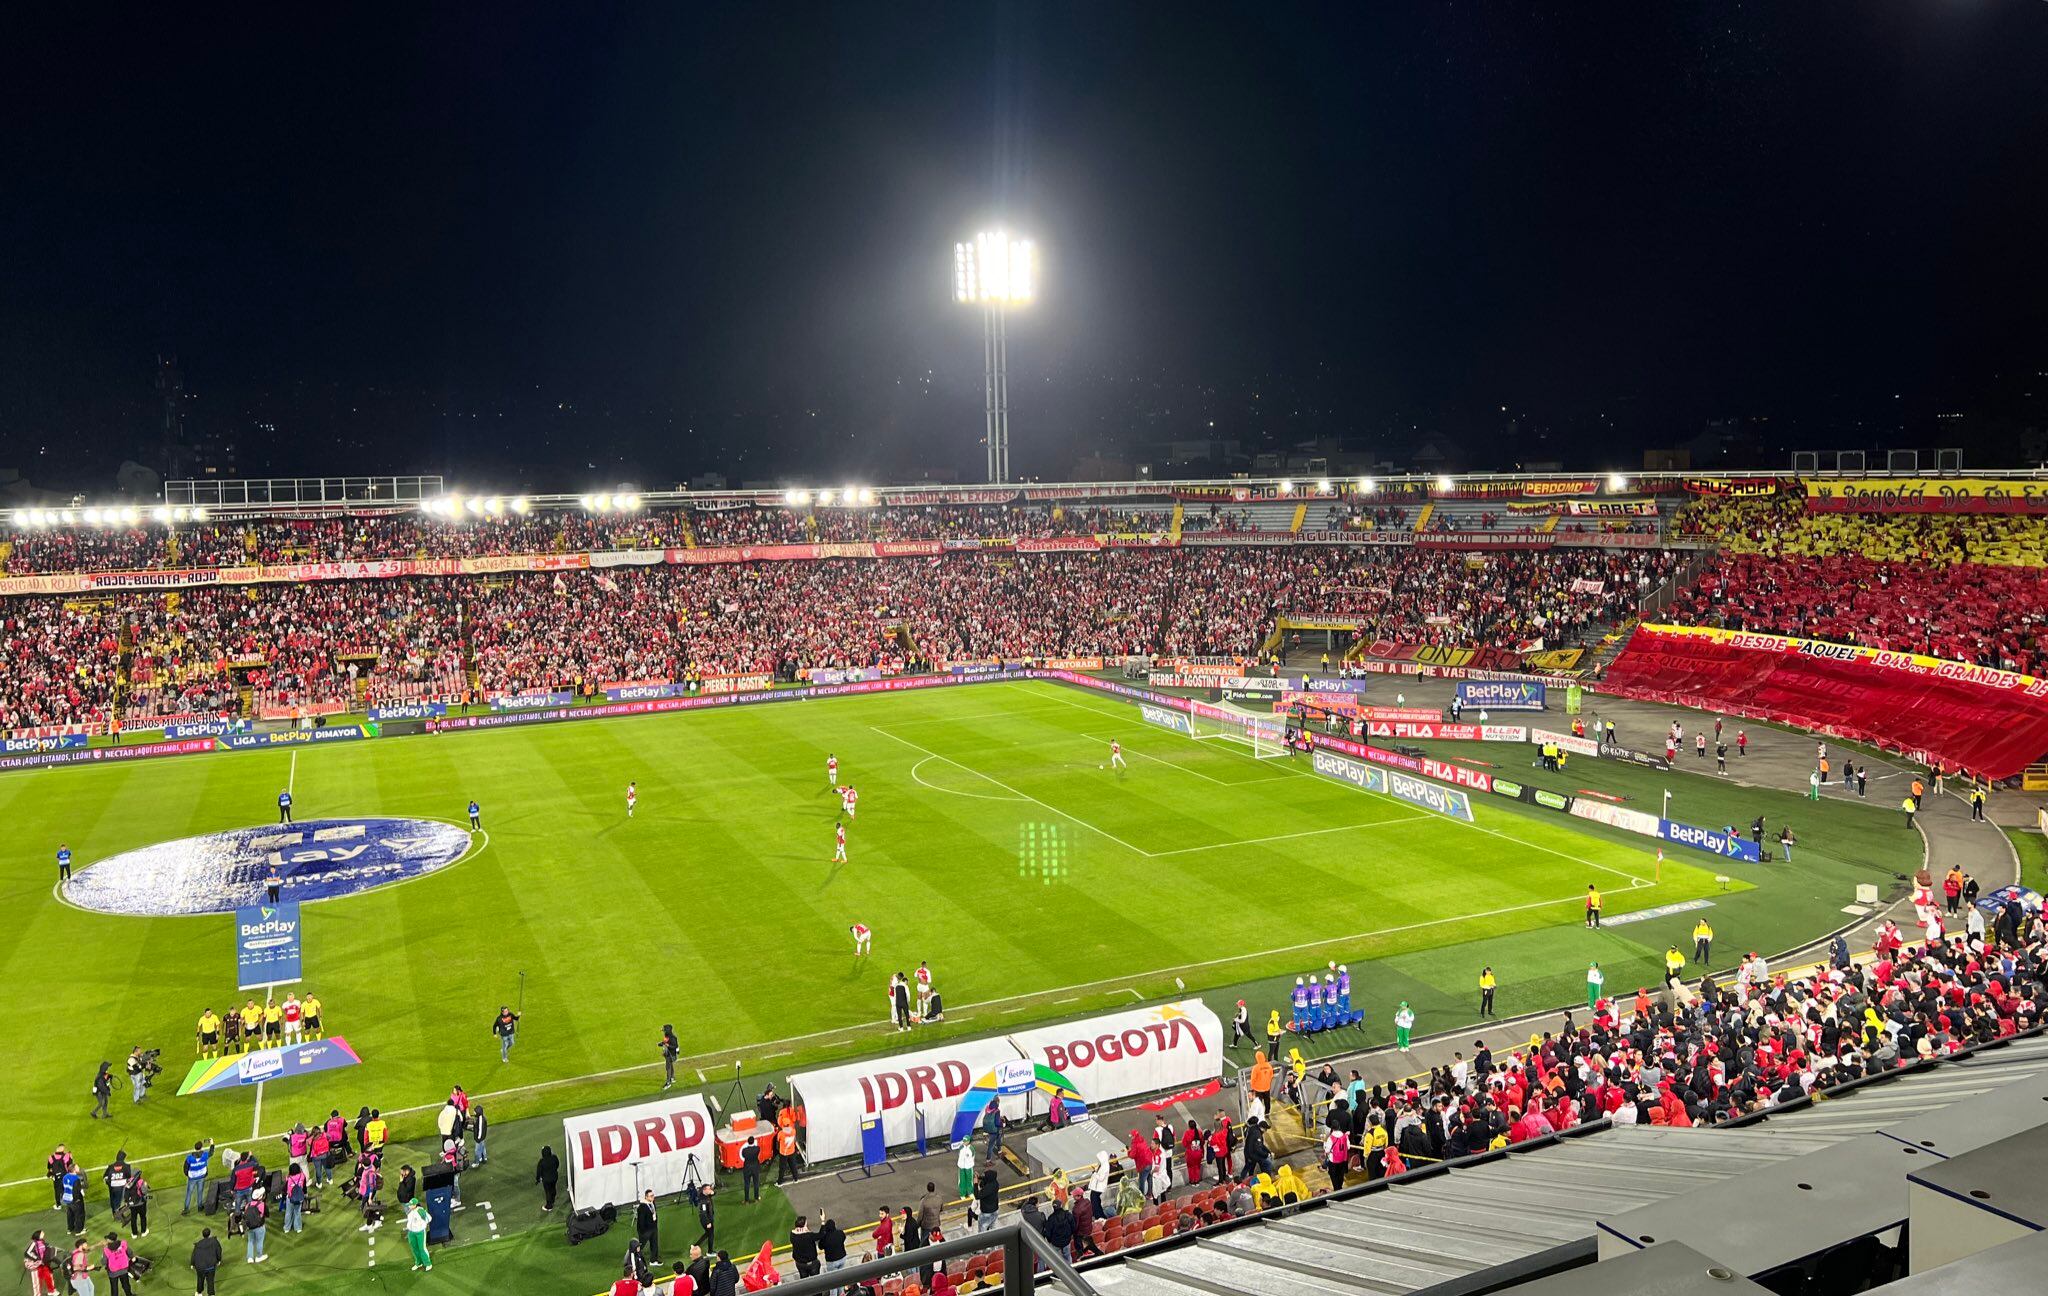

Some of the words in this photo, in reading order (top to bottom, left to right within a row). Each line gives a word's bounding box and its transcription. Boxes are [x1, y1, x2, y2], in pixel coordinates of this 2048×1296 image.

[1250, 486, 1278, 499] PIO
[1527, 482, 1583, 494] PERDOMO
[905, 493, 942, 504] BANDA
[946, 491, 963, 503] DEL
[968, 490, 1016, 502] EXPRESO
[1843, 482, 1928, 511] Bogotá
[1939, 485, 1976, 508] De
[1578, 502, 1646, 515] CLARET
[1107, 535, 1150, 547] Parche
[1296, 531, 1372, 542] AGUANTE
[1377, 532, 1412, 543] SUR
[884, 544, 931, 553] CARDENALES
[301, 563, 370, 577] BARA
[378, 562, 399, 572] 25
[96, 576, 126, 587] ROJO
[134, 573, 181, 585] BOGOTA
[187, 572, 217, 583] ROJO
[1728, 633, 1788, 652] DESDE
[1053, 660, 1098, 669] GATORADE
[1187, 656, 1243, 666] SIEMPR
[1192, 666, 1239, 676] GATORADE
[1362, 662, 1384, 673] SIGO
[1388, 664, 1398, 673] A
[1401, 665, 1437, 677] DODE
[1444, 666, 1466, 678] VAS
[705, 679, 728, 692] PIERRE
[1150, 674, 1174, 687] PIERRE
[1184, 674, 1219, 688] AGOSTINY
[619, 686, 658, 699] BetPlay
[739, 693, 760, 703] NECTAR
[1466, 684, 1522, 700] BetPlay
[506, 694, 547, 708] BetPlay
[657, 700, 679, 709] NECTAR
[694, 696, 715, 707] ESTAMOS,
[716, 695, 730, 704] LEÓN!
[379, 705, 422, 719] BetPlay
[569, 708, 592, 718] NECTAR
[592, 706, 607, 716] ¡AQUÍ
[607, 703, 630, 714] ESTAMOS,
[1144, 706, 1175, 729] BetPlay
[122, 717, 160, 732] BUENOS
[162, 712, 220, 727] MUCHACHOS
[451, 718, 467, 728] LEÓN!
[479, 716, 503, 726] NECTAR
[503, 714, 518, 725] ¡AQUÍ
[518, 711, 543, 722] ESTAMOS,
[543, 710, 558, 719] LEÓN!
[176, 722, 226, 737] BetPlay
[1396, 723, 1434, 738] FILA
[1440, 725, 1475, 733] ALLEN
[1486, 727, 1520, 735] ALLEN
[6, 737, 58, 751] BetPay
[233, 736, 258, 746] LIGA
[270, 731, 312, 743] BetPlay
[315, 728, 357, 739] DIMAYOR
[105, 749, 134, 759] NECTAR
[135, 746, 153, 756] ¡AQUÍ
[153, 743, 181, 754] ESTAMOS,
[182, 741, 201, 751] LEÓN!
[0, 759, 21, 768] CTAR
[22, 755, 42, 766] ¡AQUÍ
[42, 752, 71, 764] ESTAMOS,
[72, 751, 91, 761] LEÓN!
[1316, 753, 1366, 787] BetPlay
[1424, 760, 1454, 782] FILA
[1457, 768, 1489, 790] FILA
[1391, 775, 1446, 814] BetPlay
[1670, 823, 1726, 855] BetPlay
[241, 919, 296, 936] BetPlay
[299, 1047, 322, 1057] BetPlay
[253, 1057, 279, 1070] BetPlay
[1008, 1069, 1032, 1079] BetPlay
[858, 1059, 971, 1114] IDRD
[578, 1109, 706, 1170] IDRD
